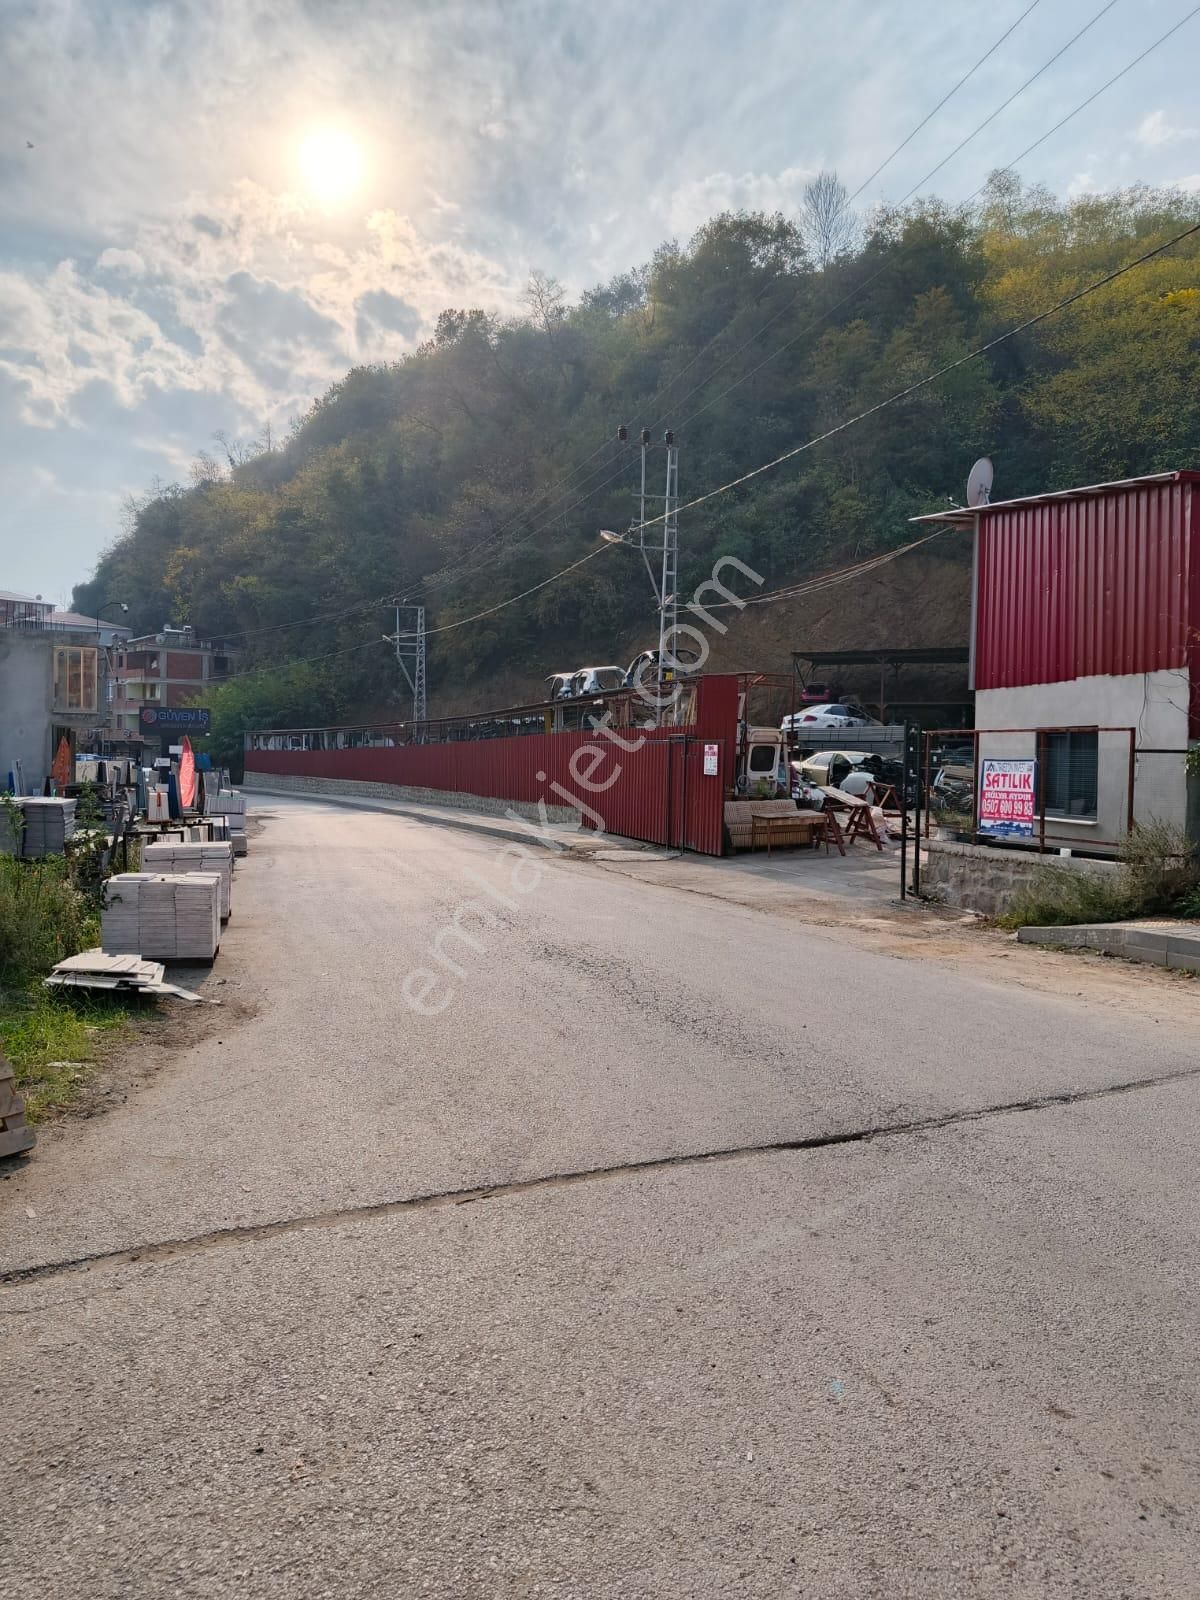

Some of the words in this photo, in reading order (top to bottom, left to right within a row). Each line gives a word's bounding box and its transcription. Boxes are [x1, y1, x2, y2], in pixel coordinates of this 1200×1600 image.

[158, 709, 196, 721] GÜVEN
[985, 772, 1031, 790] SATILIK
[982, 798, 999, 813] 0507
